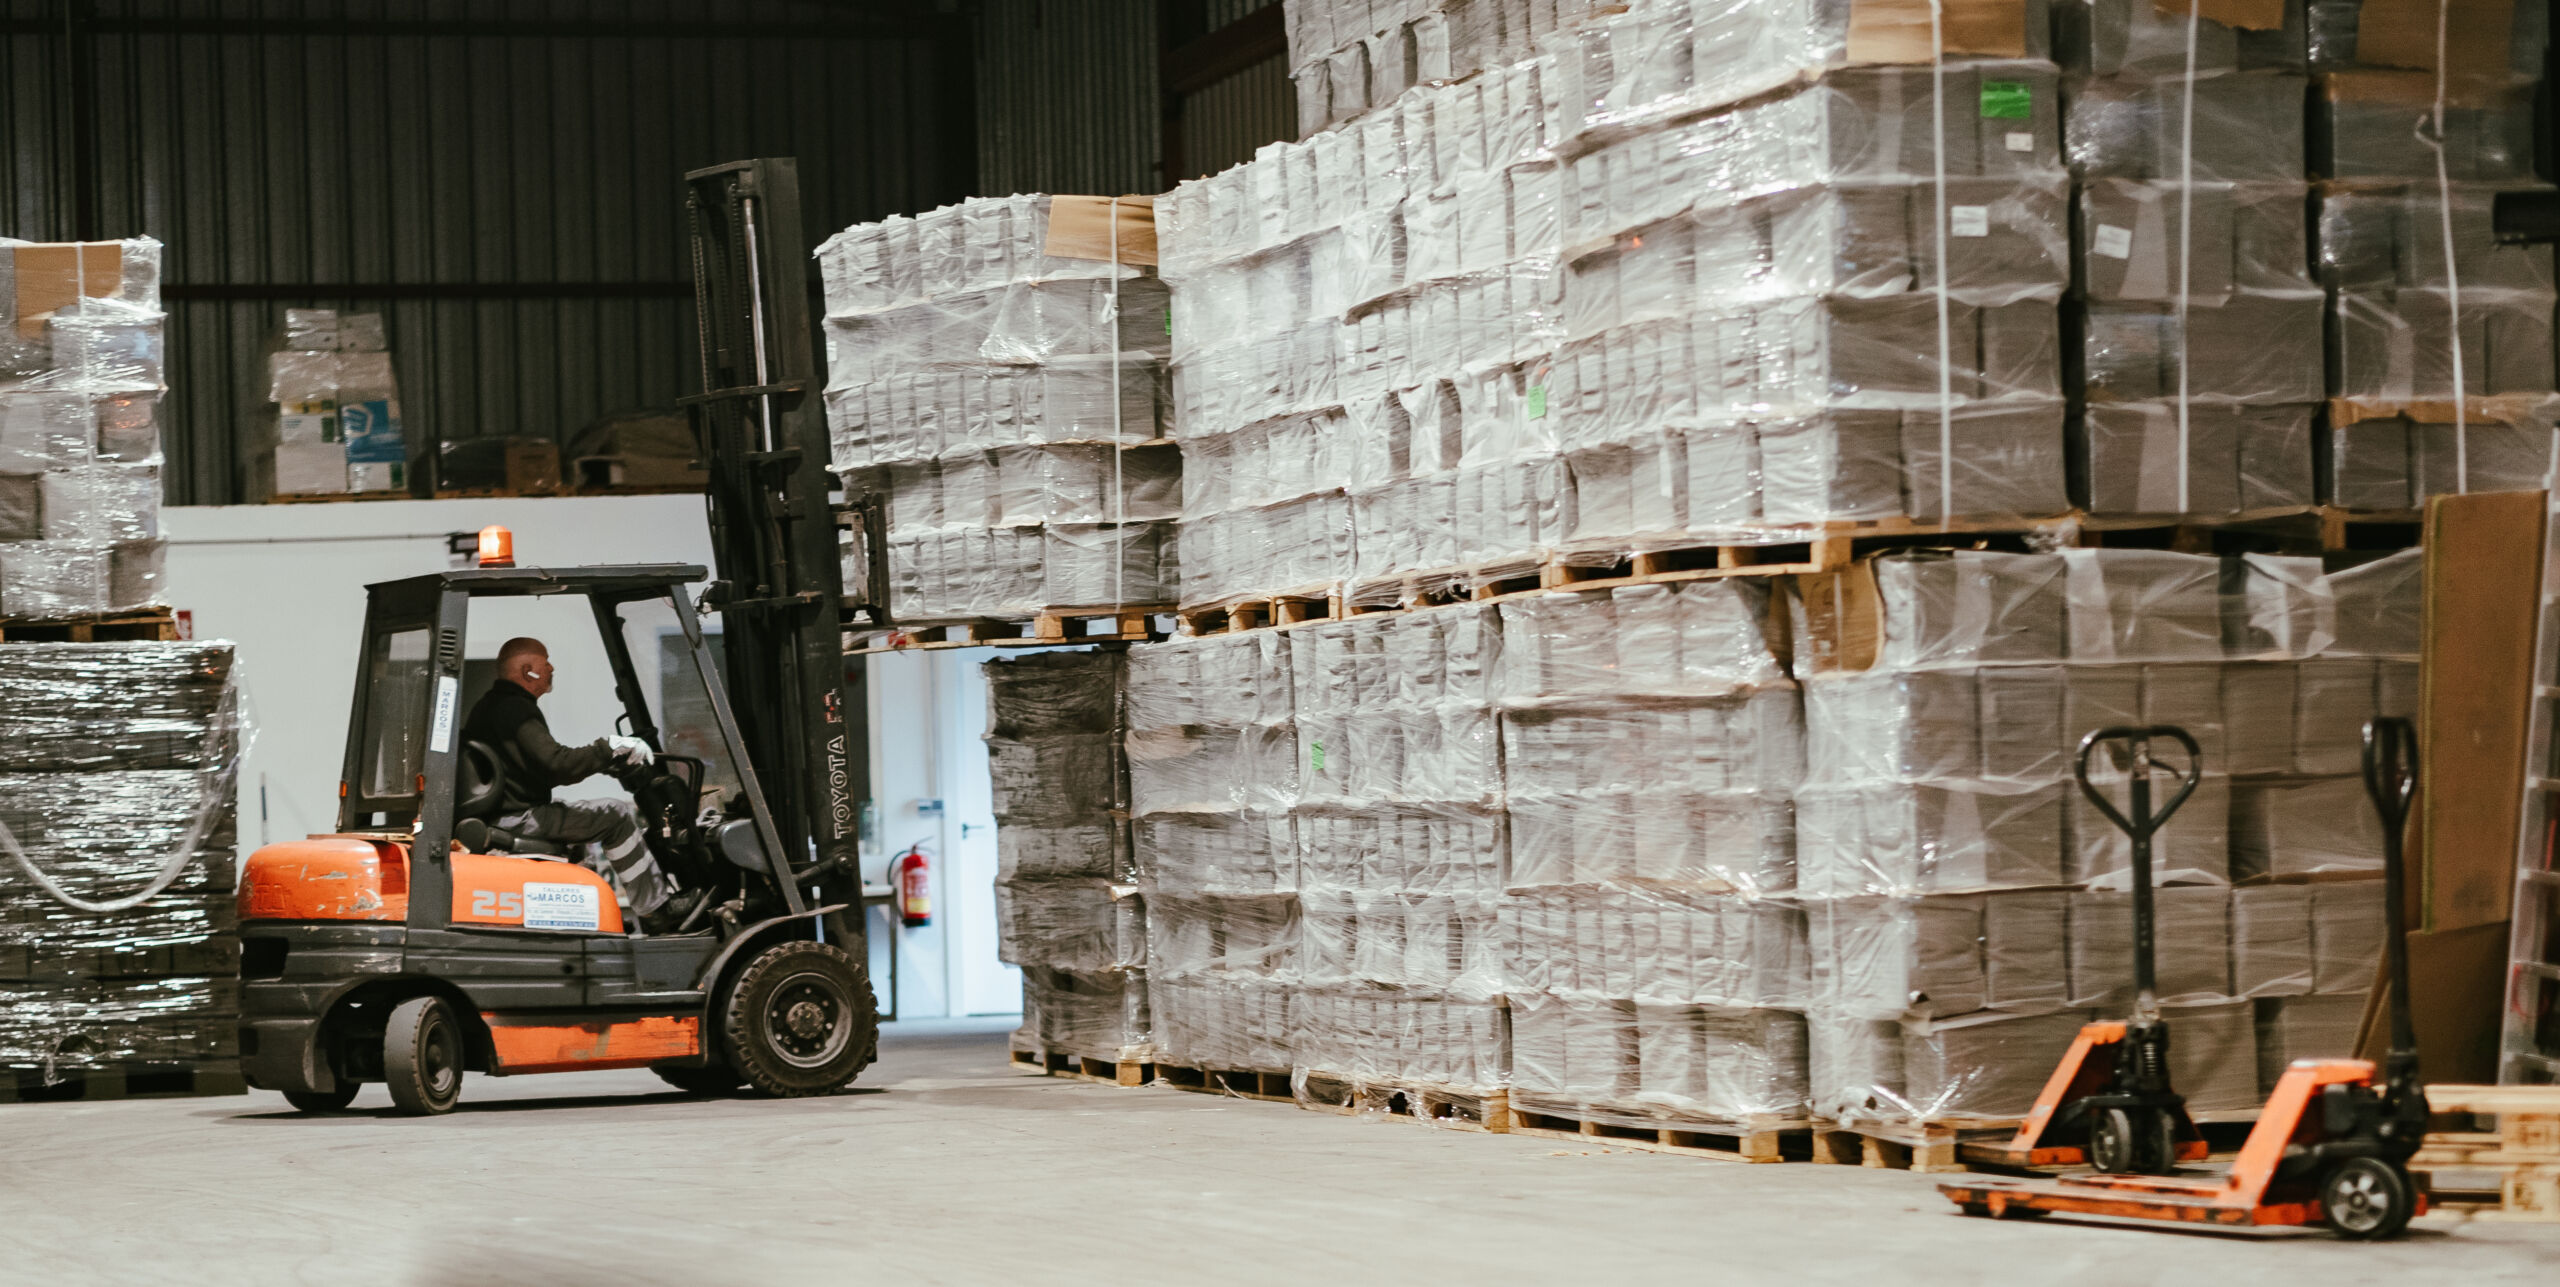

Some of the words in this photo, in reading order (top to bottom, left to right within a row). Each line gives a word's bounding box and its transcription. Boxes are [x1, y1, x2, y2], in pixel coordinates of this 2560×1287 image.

[440, 691, 450, 728] MARCOS
[827, 735, 850, 839] TOYOTA
[472, 889, 522, 918] 25
[538, 893, 585, 903] MARCOS
